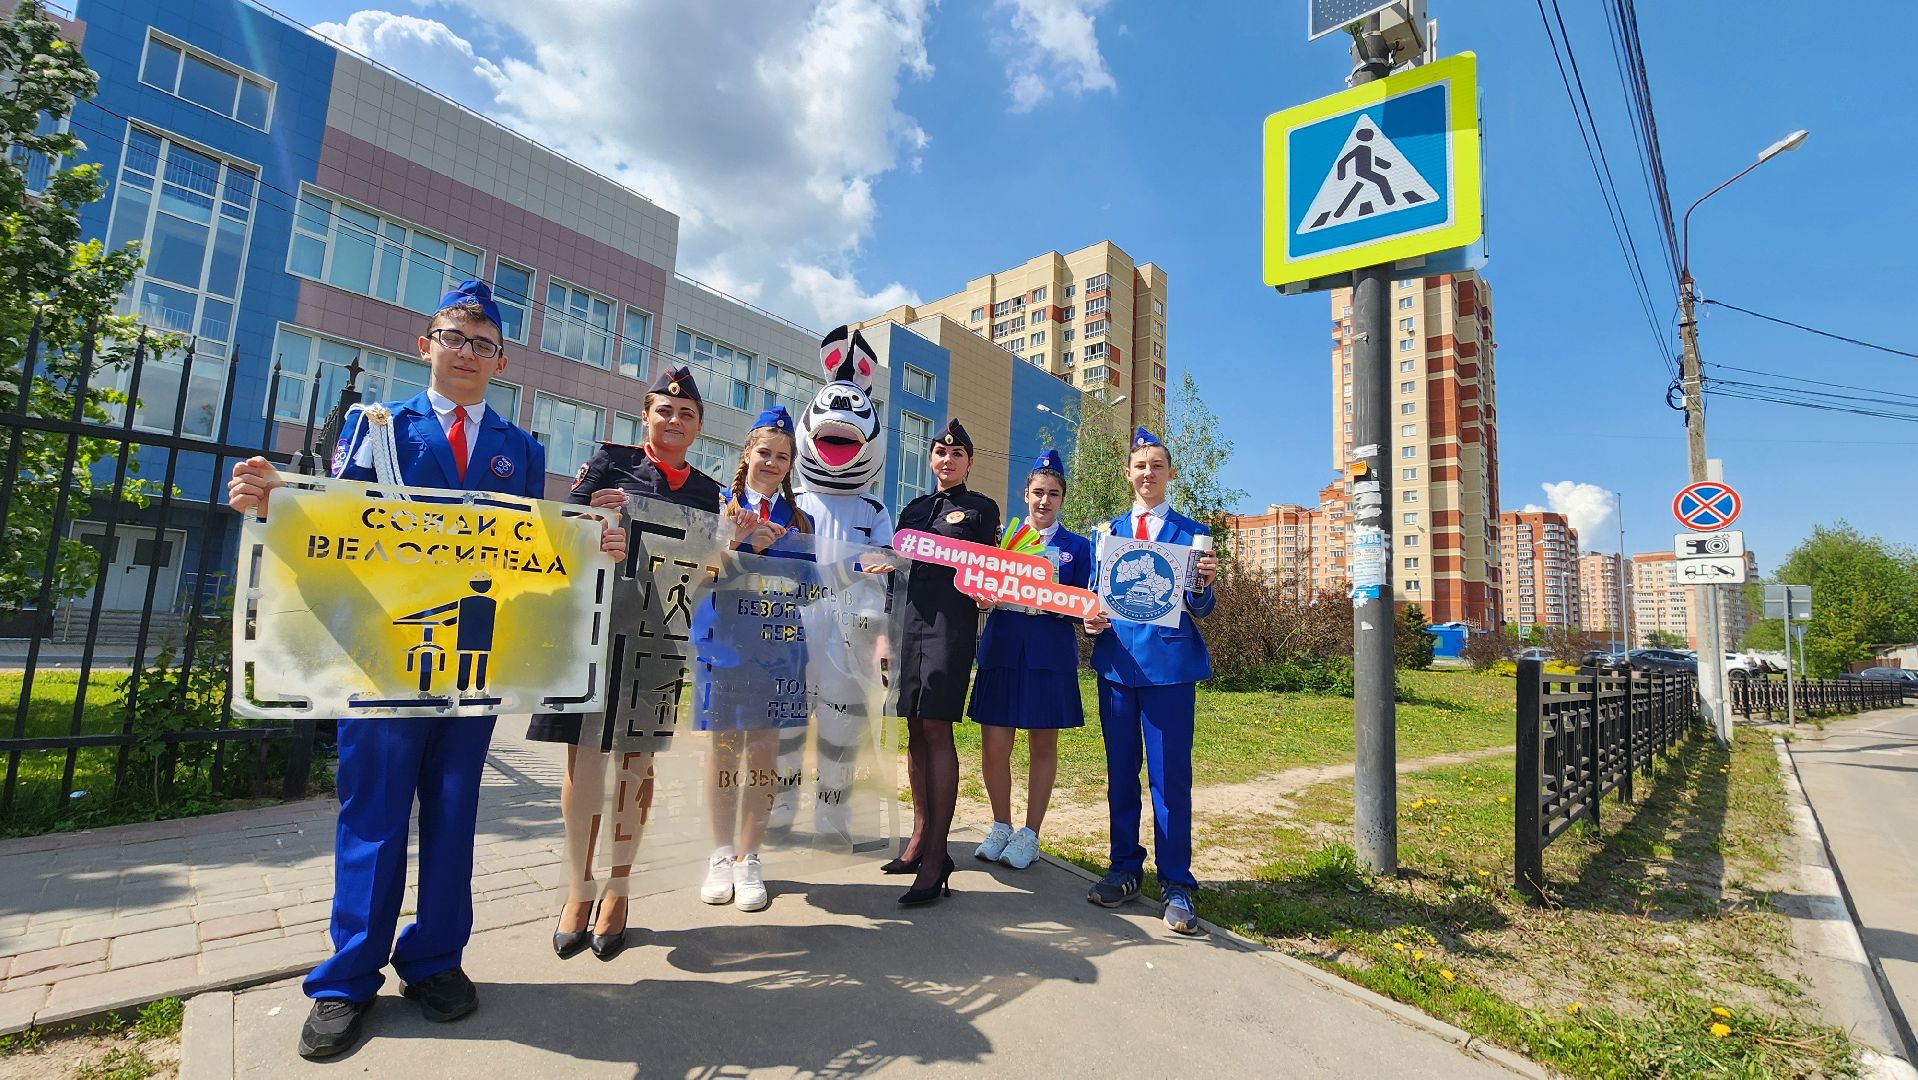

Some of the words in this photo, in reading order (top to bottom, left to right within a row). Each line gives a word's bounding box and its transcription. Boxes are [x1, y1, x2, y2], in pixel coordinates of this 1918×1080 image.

[514, 520, 535, 542] С
[307, 534, 568, 576] ВЕЛОСИПЕДА
[900, 533, 1046, 581] #Внимание
[1103, 542, 1181, 598] ГОСАВТОИНСПЕКЦИЯ
[963, 566, 1096, 614] НаДорогу
[738, 598, 868, 629] БЕЗОПОСТИ
[767, 701, 848, 719] ПЕШМ
